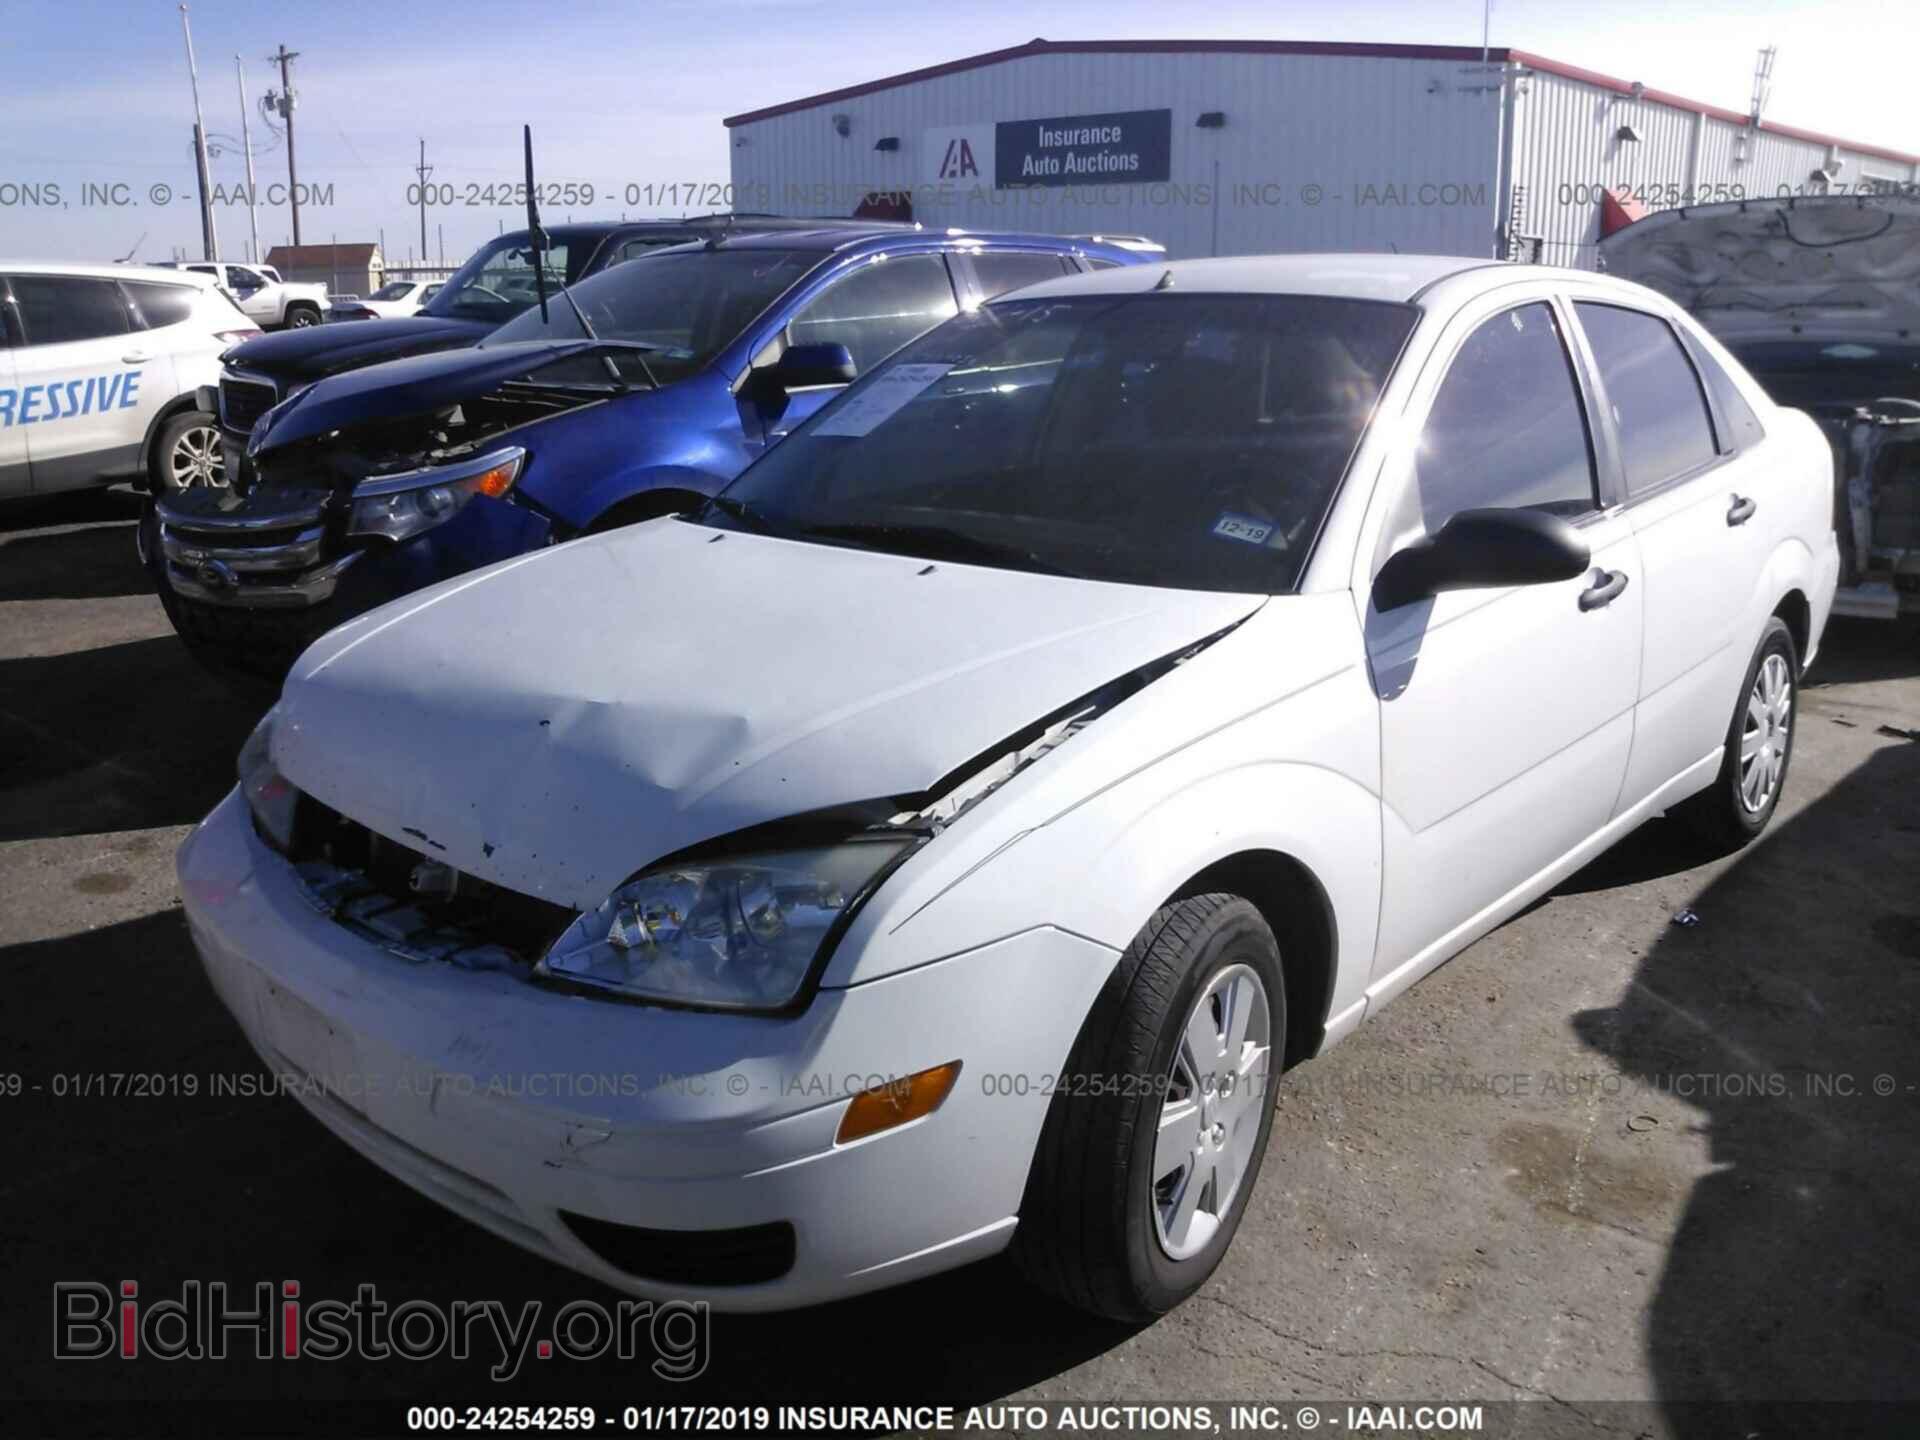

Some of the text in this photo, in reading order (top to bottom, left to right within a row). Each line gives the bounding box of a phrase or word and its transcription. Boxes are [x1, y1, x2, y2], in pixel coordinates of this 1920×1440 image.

[1039, 126, 1121, 147] Insurance
[1022, 150, 1139, 176] Auto Auctions
[0, 371, 141, 427] RESSIVE
